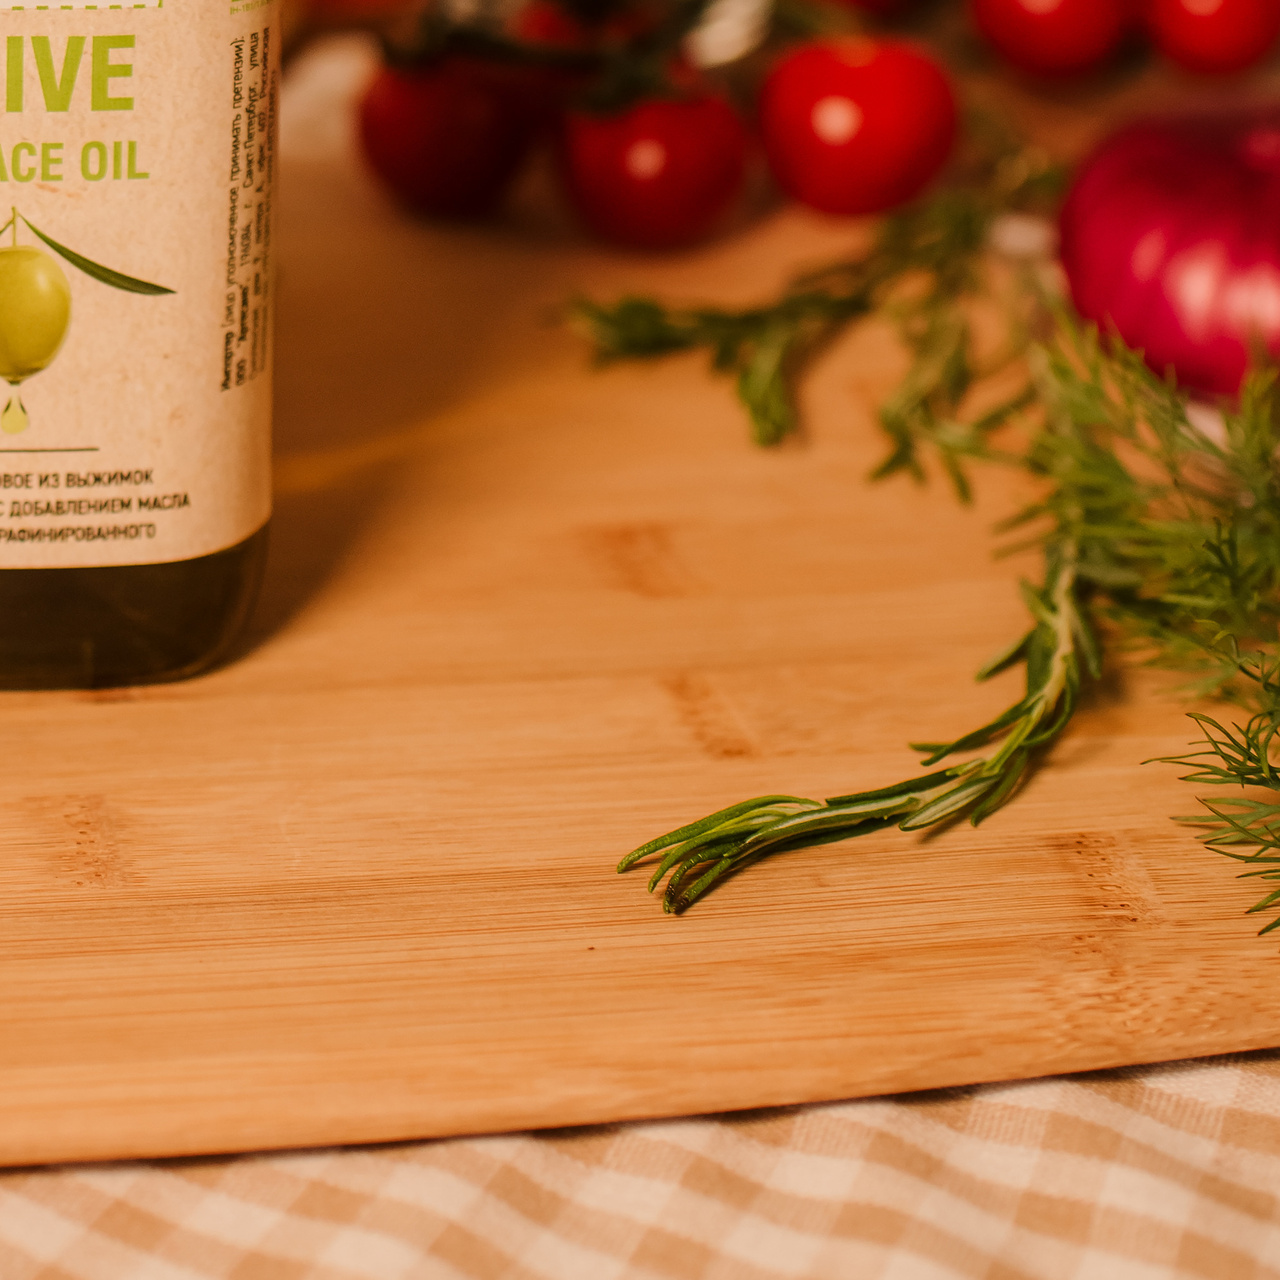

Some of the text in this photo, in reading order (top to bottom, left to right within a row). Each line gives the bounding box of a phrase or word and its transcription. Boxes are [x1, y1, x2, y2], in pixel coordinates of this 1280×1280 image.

[249, 32, 260, 70] улица
[230, 36, 245, 109] претензии):
[80, 140, 151, 182] OIL
[229, 114, 242, 182] принимать
[38, 472, 60, 489] ИЗ
[66, 469, 154, 488] ВЫЖИМОК
[10, 497, 132, 518] ДОБАВЛЕНИЕМ
[138, 492, 191, 510] МАСЛА
